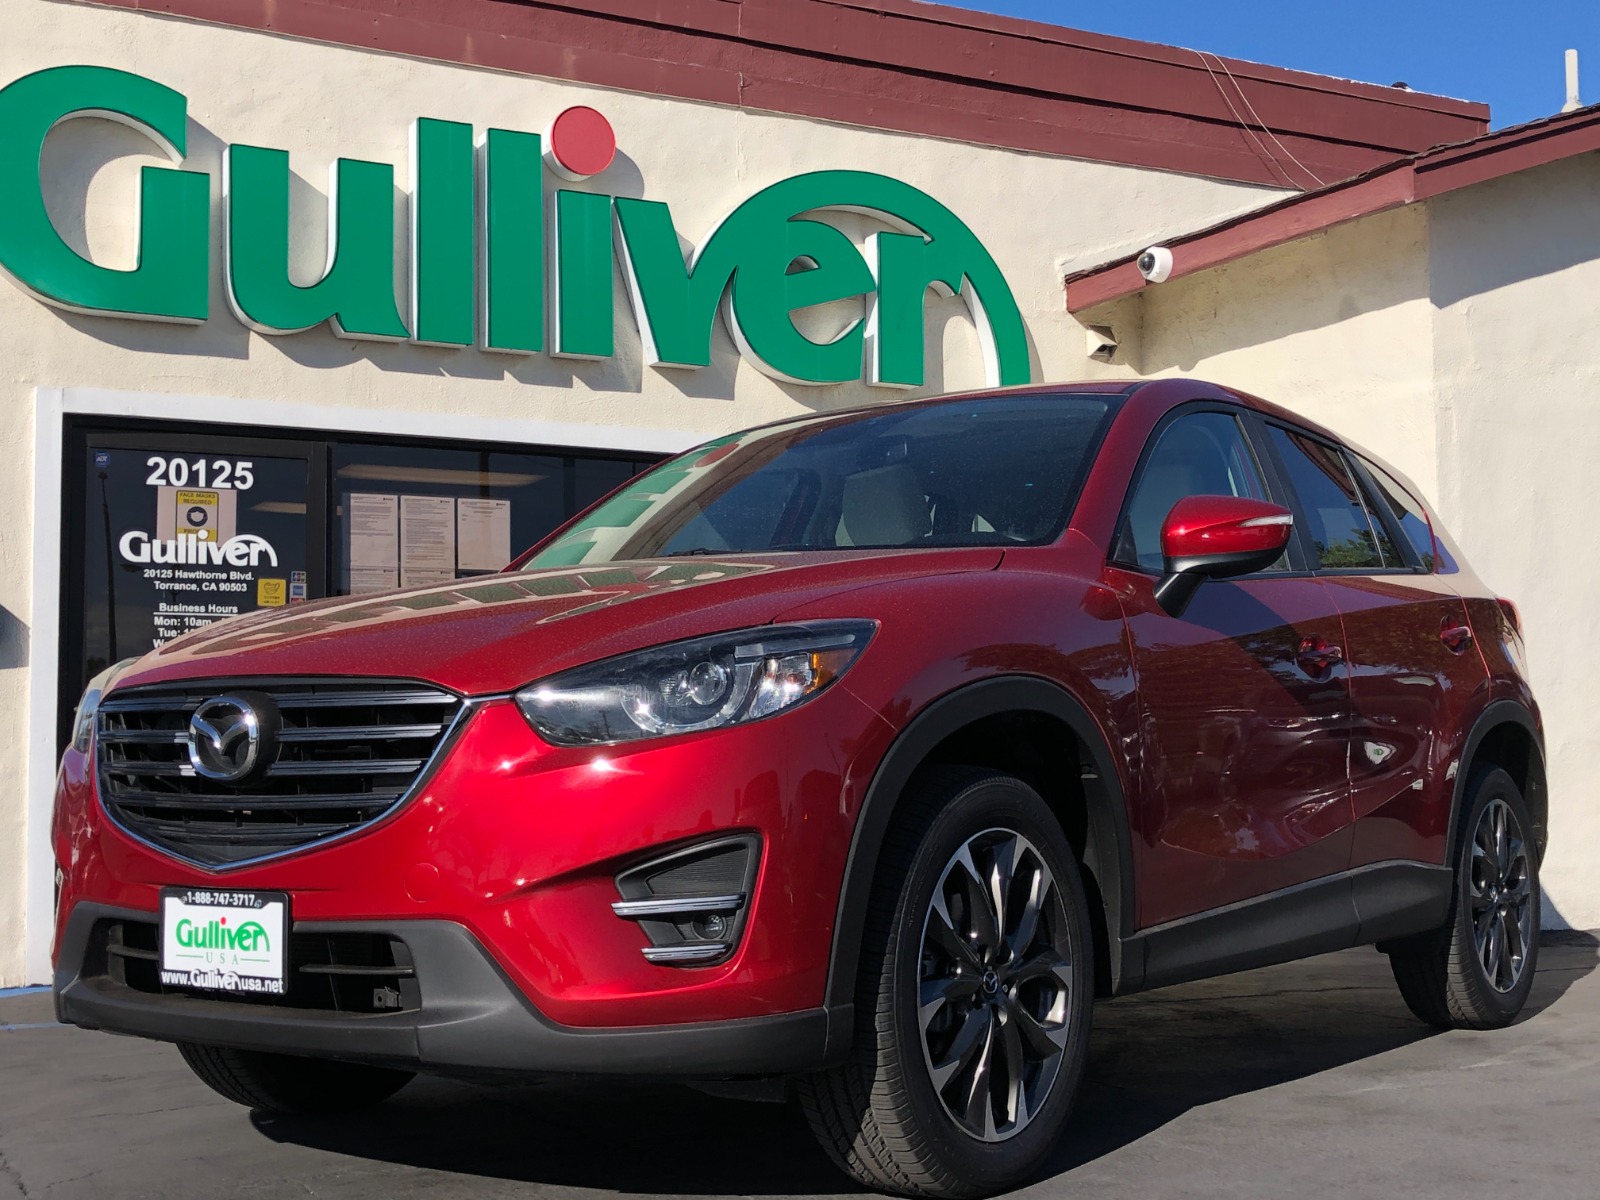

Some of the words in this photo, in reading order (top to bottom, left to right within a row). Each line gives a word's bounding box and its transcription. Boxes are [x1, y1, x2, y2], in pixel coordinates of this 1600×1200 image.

[0, 65, 1030, 389] Gulliver
[146, 457, 254, 490] 20125
[119, 529, 278, 567] Gulliver
[143, 569, 173, 579] 20125
[175, 570, 228, 580] Hawthorne
[230, 571, 255, 581] Blvd.
[154, 581, 200, 592] Torrance,
[202, 582, 217, 591] CA
[219, 583, 247, 592] 90503
[159, 603, 206, 613] Business
[208, 604, 239, 614] Hours
[154, 616, 181, 627] Mon:
[184, 617, 212, 627] 10am
[157, 627, 181, 638] Tue:
[187, 891, 255, 907] 1-888-747-3717
[176, 916, 271, 952] Gulliver
[161, 968, 283, 993] www.Gulliverusa.net
